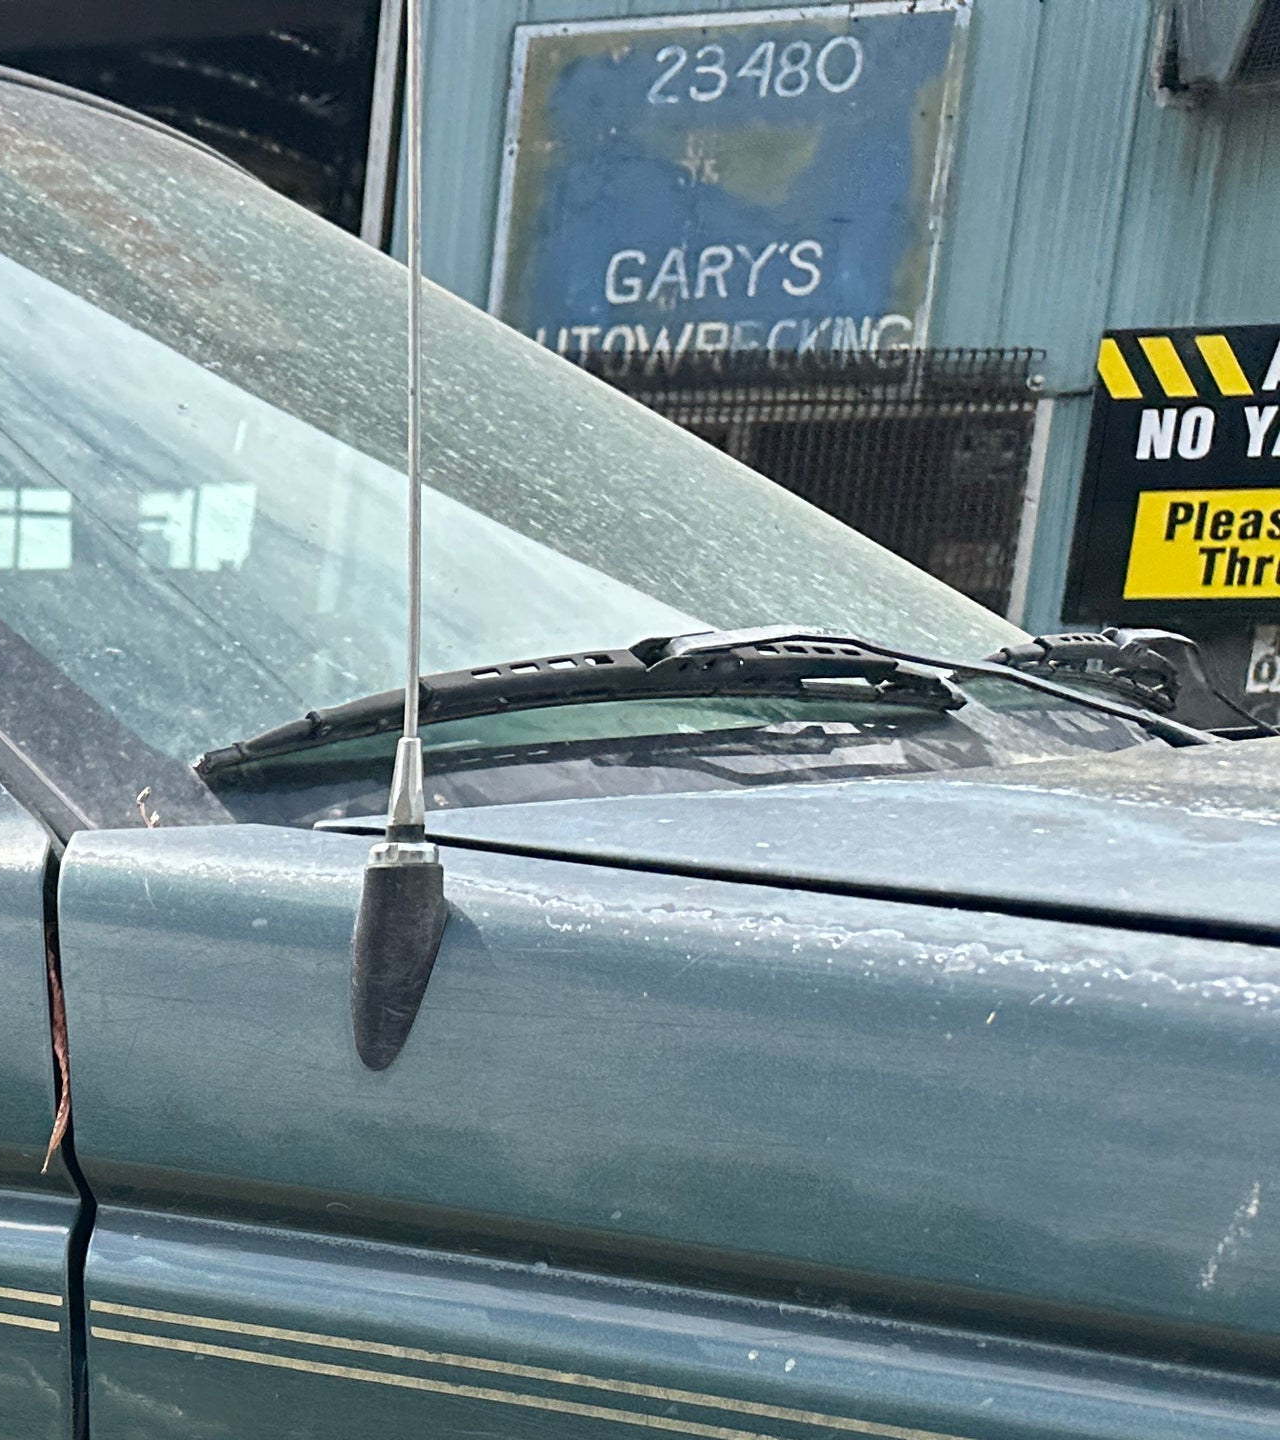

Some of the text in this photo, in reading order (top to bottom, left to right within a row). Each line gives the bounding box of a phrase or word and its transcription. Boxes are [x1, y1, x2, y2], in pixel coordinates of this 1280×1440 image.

[646, 36, 864, 104] 23480
[604, 239, 824, 305] GARY'S
[1135, 404, 1280, 460] NO Y
[1199, 546, 1280, 587] Thr
